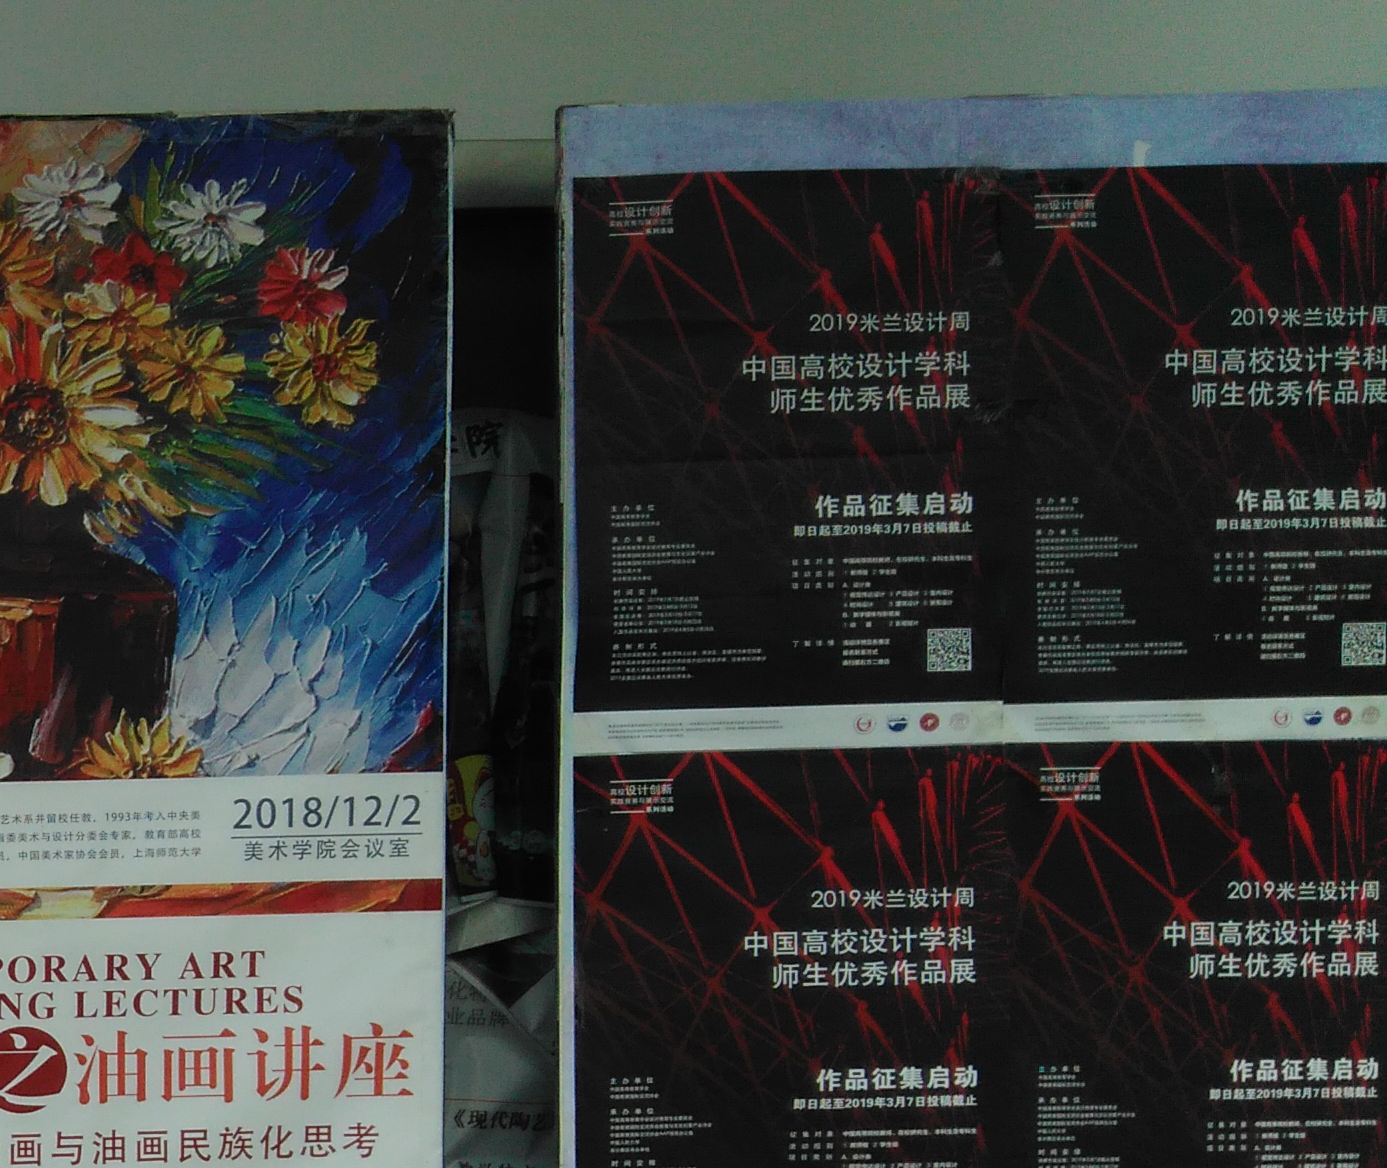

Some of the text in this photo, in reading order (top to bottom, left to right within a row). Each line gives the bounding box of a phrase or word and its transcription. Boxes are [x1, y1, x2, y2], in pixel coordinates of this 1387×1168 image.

[808, 310, 971, 335] 2019米兰设计周
[1230, 305, 1387, 329] 2019米兰设计周
[741, 350, 972, 384] 中国高校设计学科
[1163, 346, 1387, 379] 中国高校设计学科
[769, 382, 972, 416] 师生优秀作品展
[1190, 378, 1387, 410] 师生优秀作品展
[814, 491, 974, 519] 作品征集启动
[1236, 487, 1387, 513] 作品征集启动
[793, 520, 974, 537] 即日起至2019年3月7日投稿截止
[1215, 516, 1387, 531] 即日起至2019年3月7日投稿截止
[232, 794, 422, 830] 2018/12/2
[244, 836, 410, 862] 美术学院会议室
[810, 887, 976, 912] 2019米兰设计周
[1226, 880, 1381, 904] 2019米兰设计周
[743, 926, 977, 960] 中国高校设计学科
[1162, 918, 1382, 951] 中国高校设计学科
[178, 949, 268, 980] ART
[771, 958, 978, 990] 师生优秀作品展
[1188, 950, 1380, 981] 师生优秀作品展
[75, 984, 306, 1019] LECTURES
[815, 1065, 979, 1092] 作品征集启动
[1229, 1057, 1379, 1083] 作品征集启动
[792, 1094, 978, 1110] 即日起至2019年3月7日投稿截止
[1208, 1086, 1378, 1101] 即日起至2019年3月7日投稿截止
